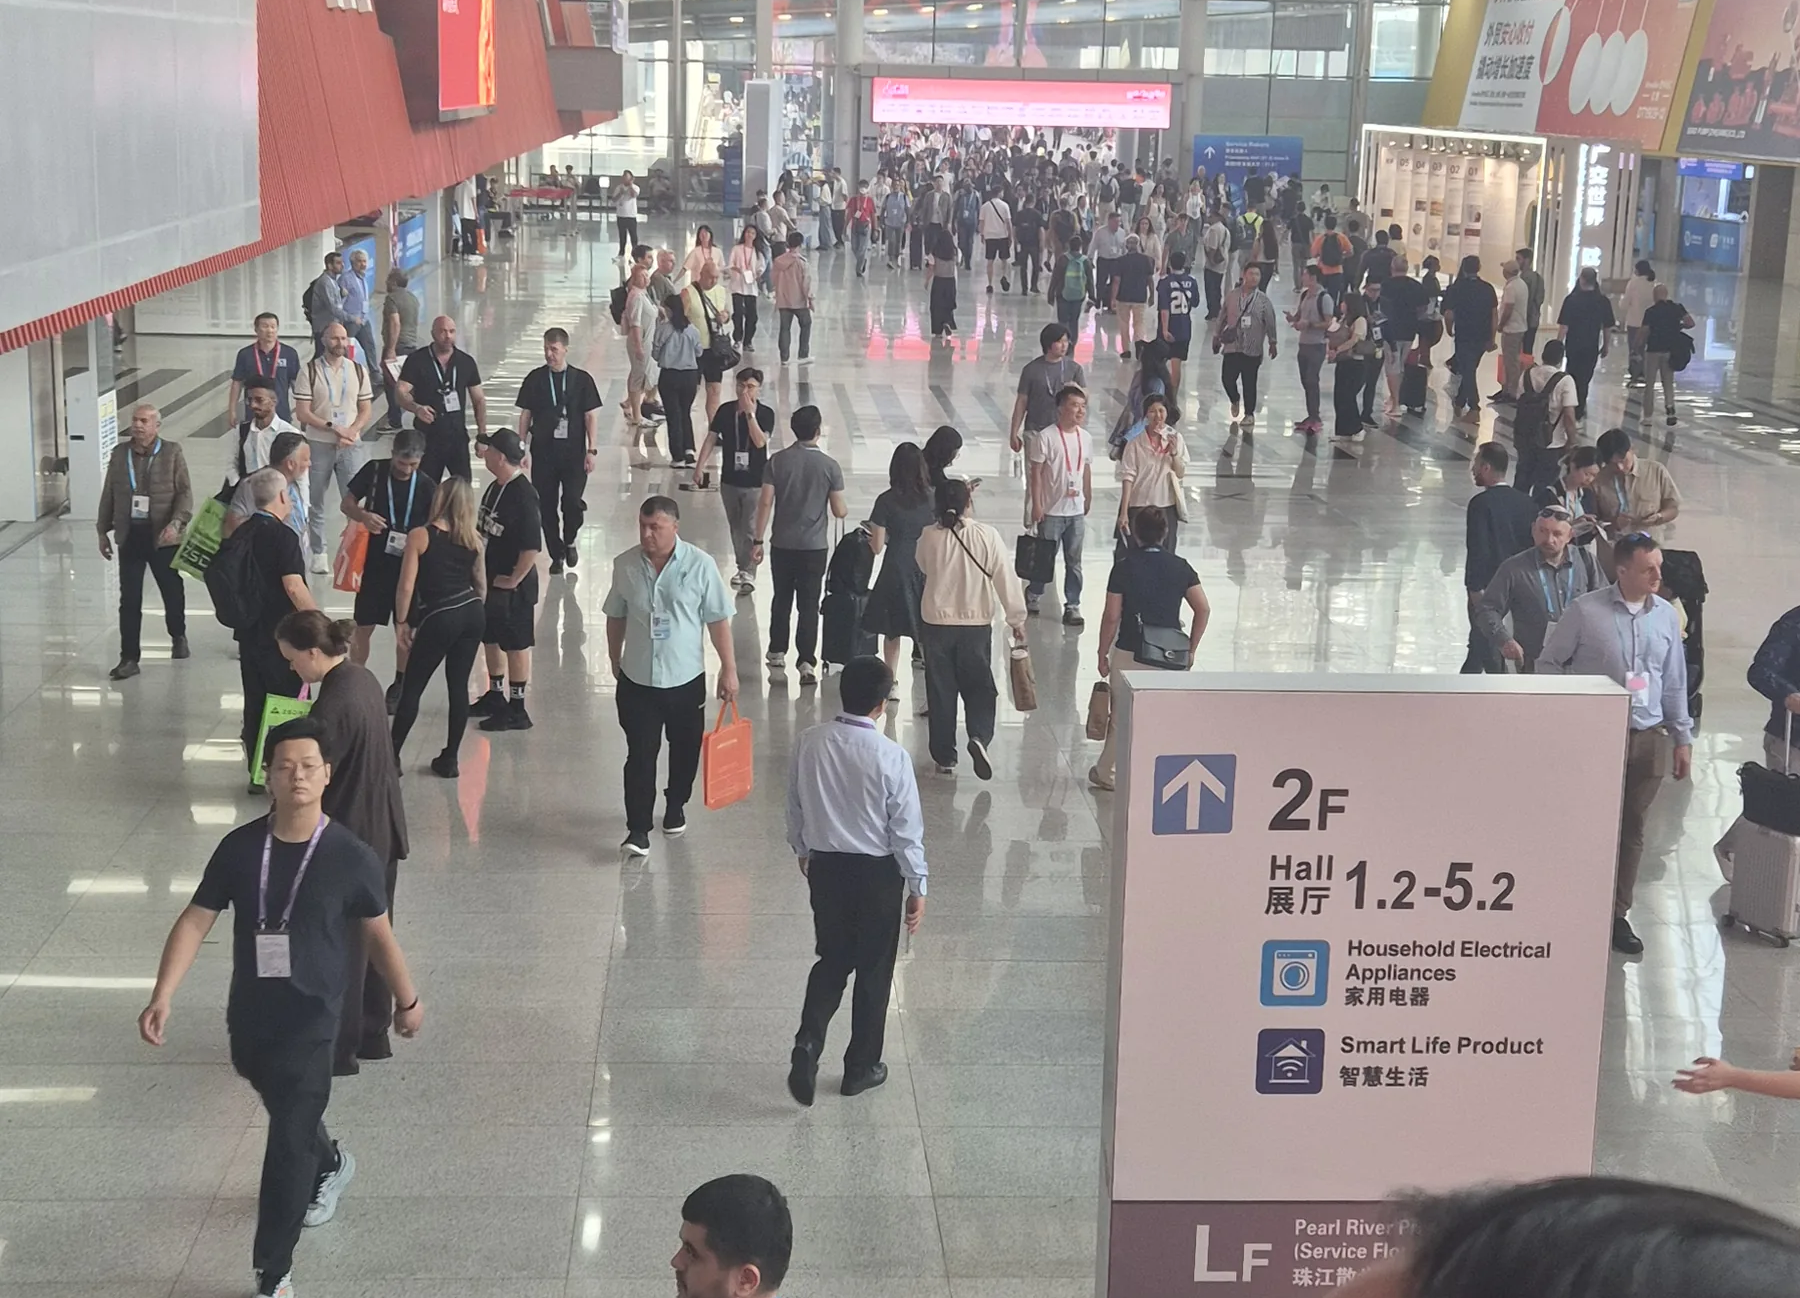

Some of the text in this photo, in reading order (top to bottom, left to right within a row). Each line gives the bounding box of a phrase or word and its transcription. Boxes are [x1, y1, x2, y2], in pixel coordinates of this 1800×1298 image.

[1415, 160, 1425, 169] 04
[1432, 162, 1442, 171] 03
[1450, 165, 1460, 174] 02
[1468, 167, 1478, 176] 01
[1268, 768, 1349, 832] 2F
[1269, 854, 1517, 913] Hall 1.2-5.2
[1264, 886, 1331, 916] 展厅
[1347, 940, 1552, 959] Household Electrical
[1345, 963, 1457, 986] Appliances
[1344, 986, 1430, 1007] 家用电器
[1340, 1036, 1544, 1055] Smart Life Product
[1339, 1065, 1430, 1088] 智慧生活
[1295, 1219, 1341, 1236] Pearl
[1346, 1219, 1393, 1237] River
[1194, 1224, 1273, 1283] LF
[1294, 1242, 1367, 1260] (Service
[1292, 1266, 1373, 1287] 珠江散
